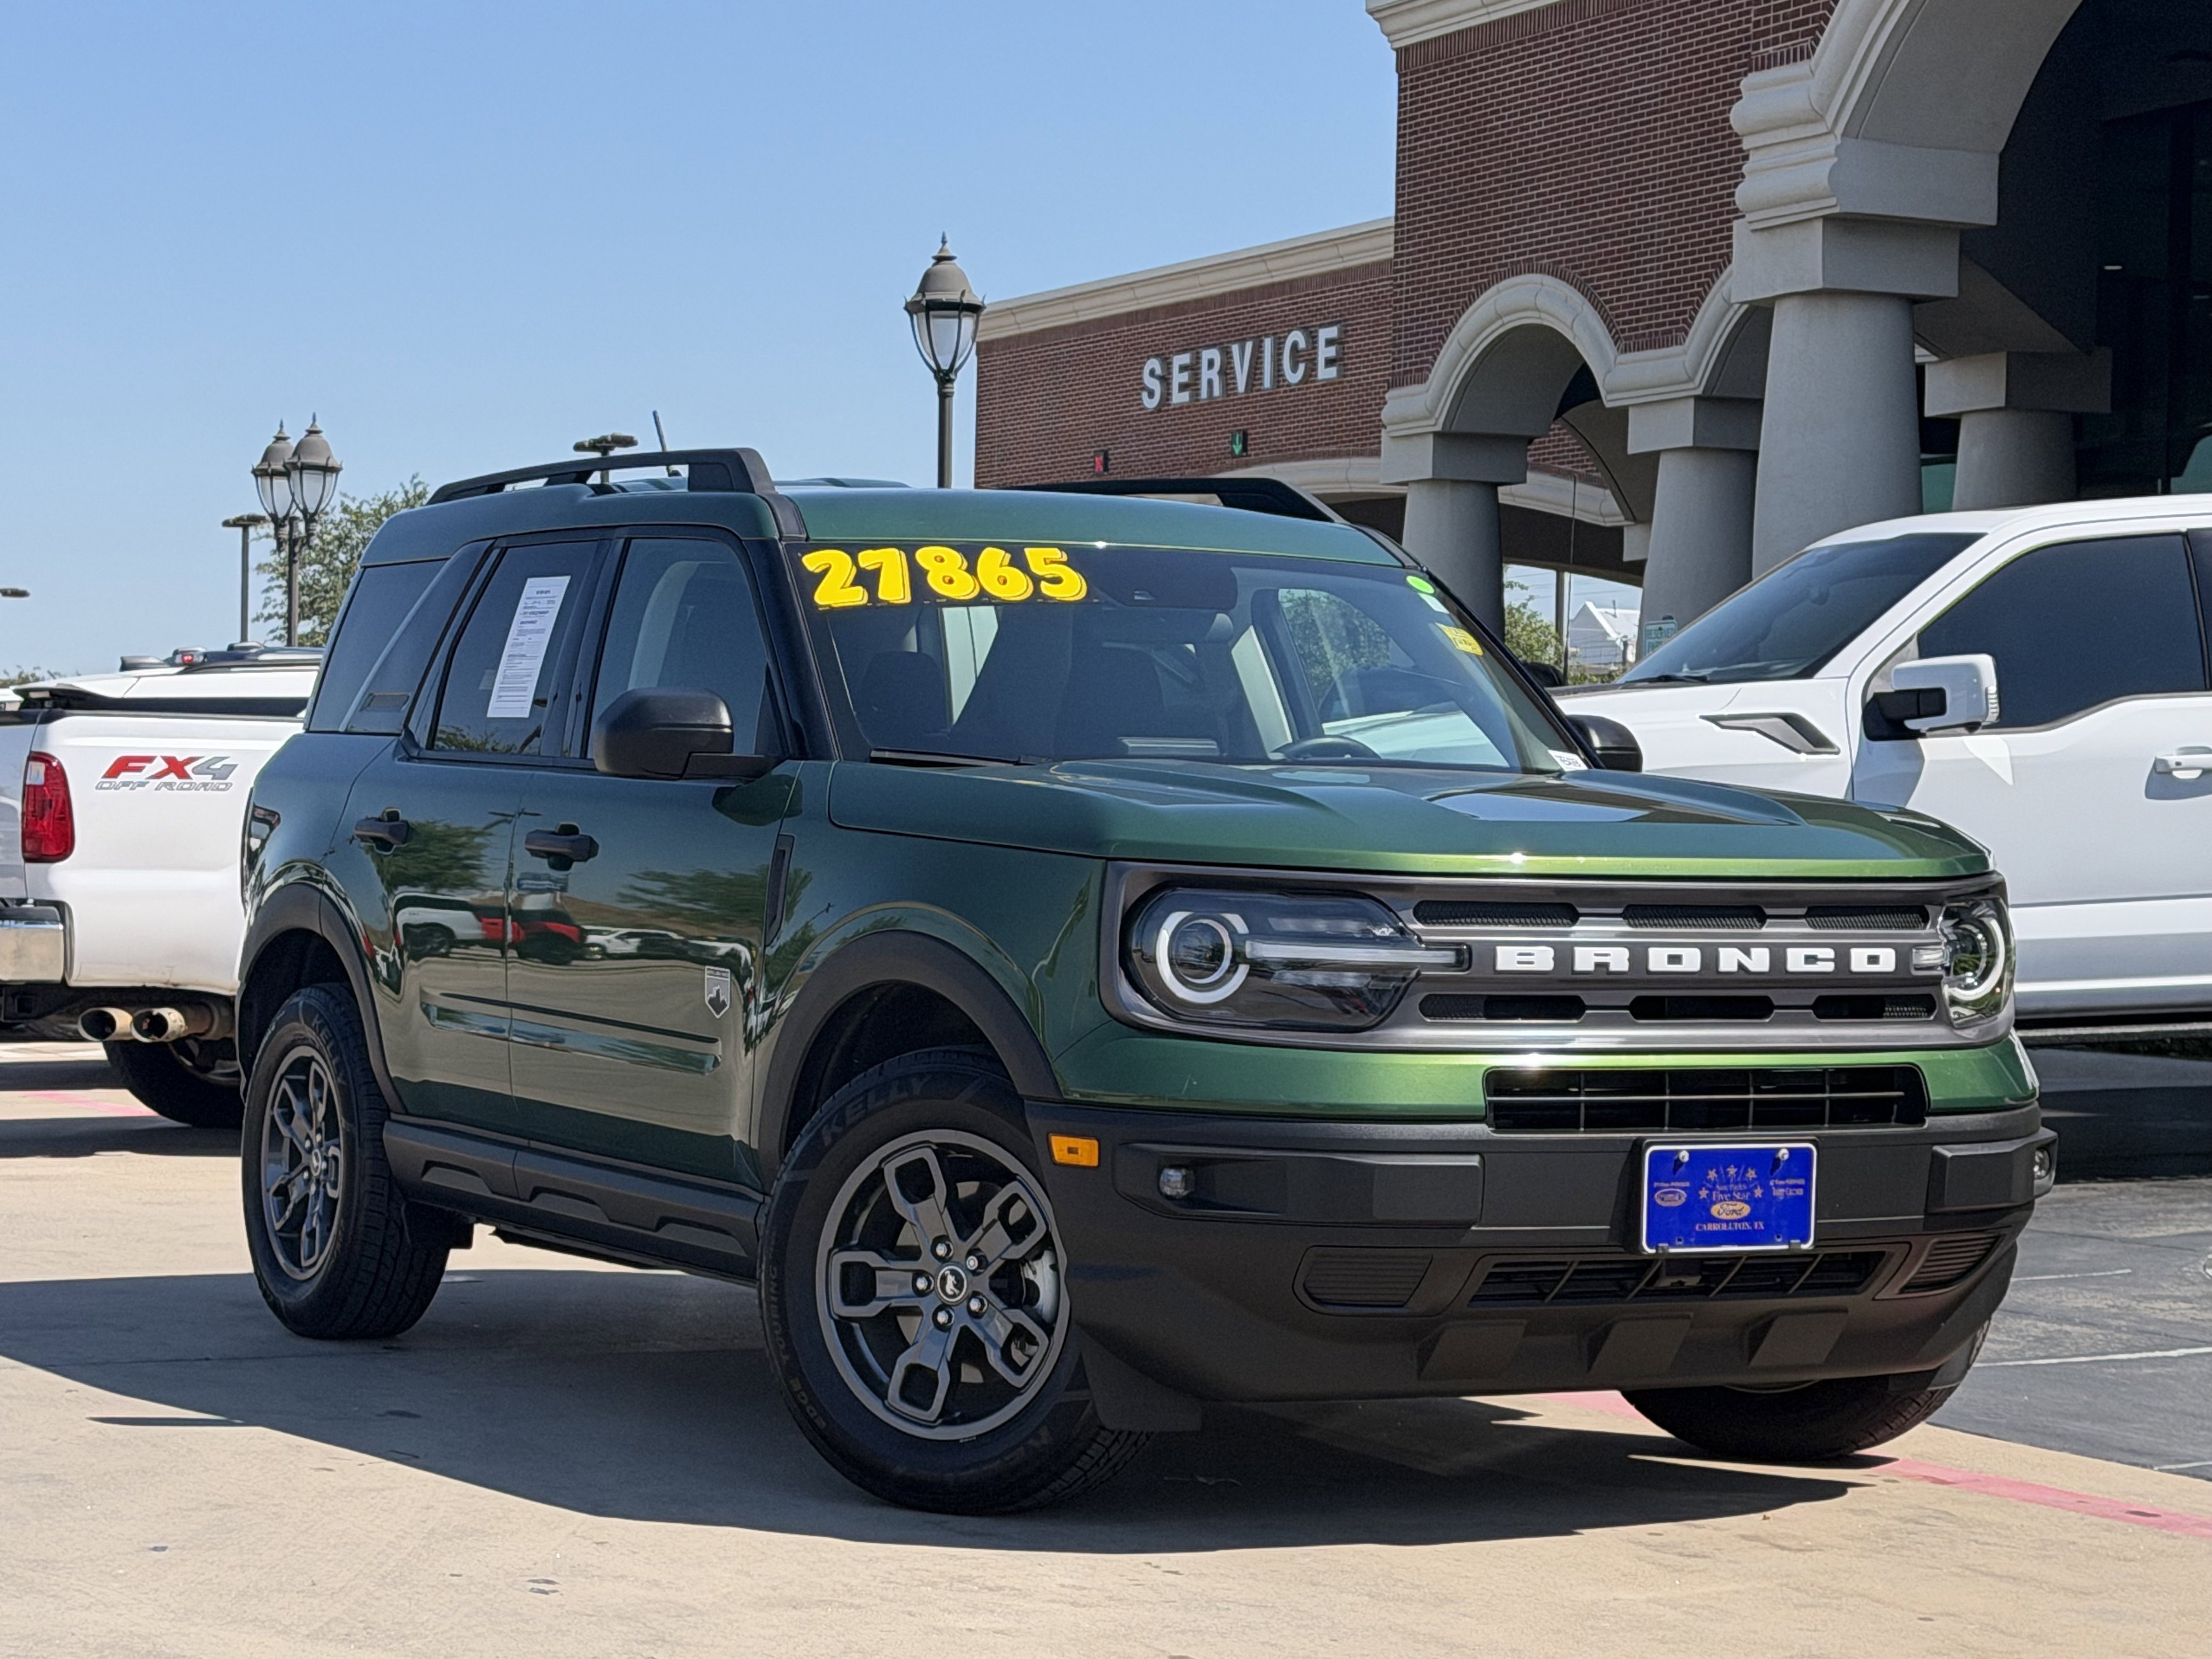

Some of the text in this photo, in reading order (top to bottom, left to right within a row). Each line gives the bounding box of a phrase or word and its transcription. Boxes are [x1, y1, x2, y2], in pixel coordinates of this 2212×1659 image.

[1141, 324, 1342, 410] SERVICE
[801, 546, 1087, 607] 27865
[101, 755, 239, 781] FX4
[95, 781, 233, 792] OFF ROAD
[1494, 945, 1897, 973] BRONCO
[312, 1013, 348, 1086] KELLY
[822, 1073, 934, 1148] KELLY
[1712, 1191, 1751, 1201] Five Star
[1717, 1203, 1745, 1216] Ford
